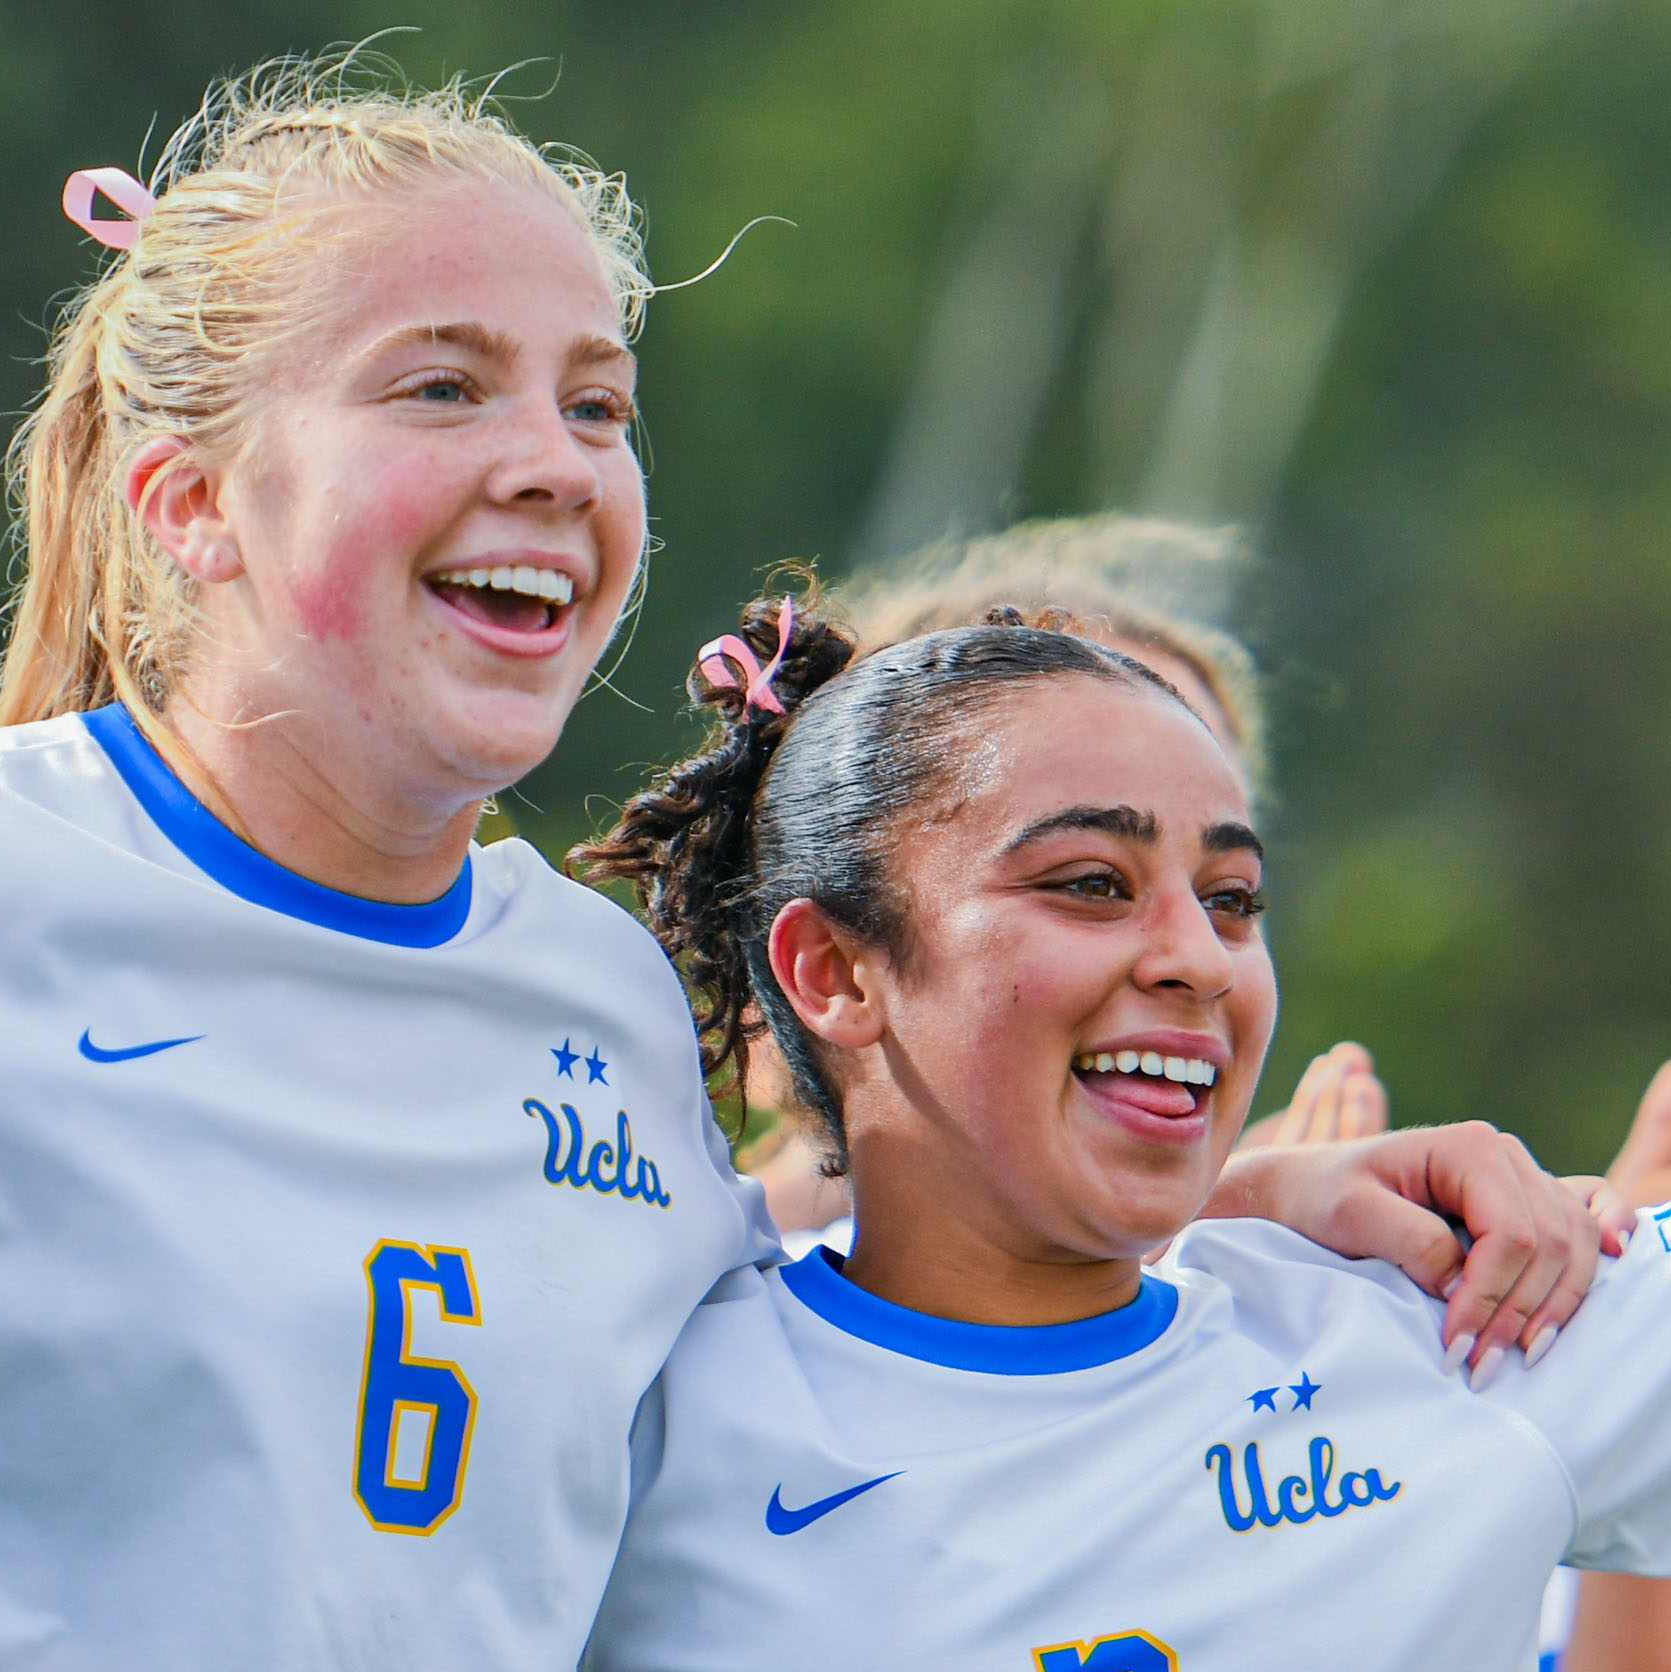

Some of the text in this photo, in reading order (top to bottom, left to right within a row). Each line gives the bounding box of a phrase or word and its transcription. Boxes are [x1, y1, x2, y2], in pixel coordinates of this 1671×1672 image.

[522, 1096, 674, 1211] Ucla
[351, 1236, 484, 1538] 6
[1203, 1435, 1405, 1536] Ucla
